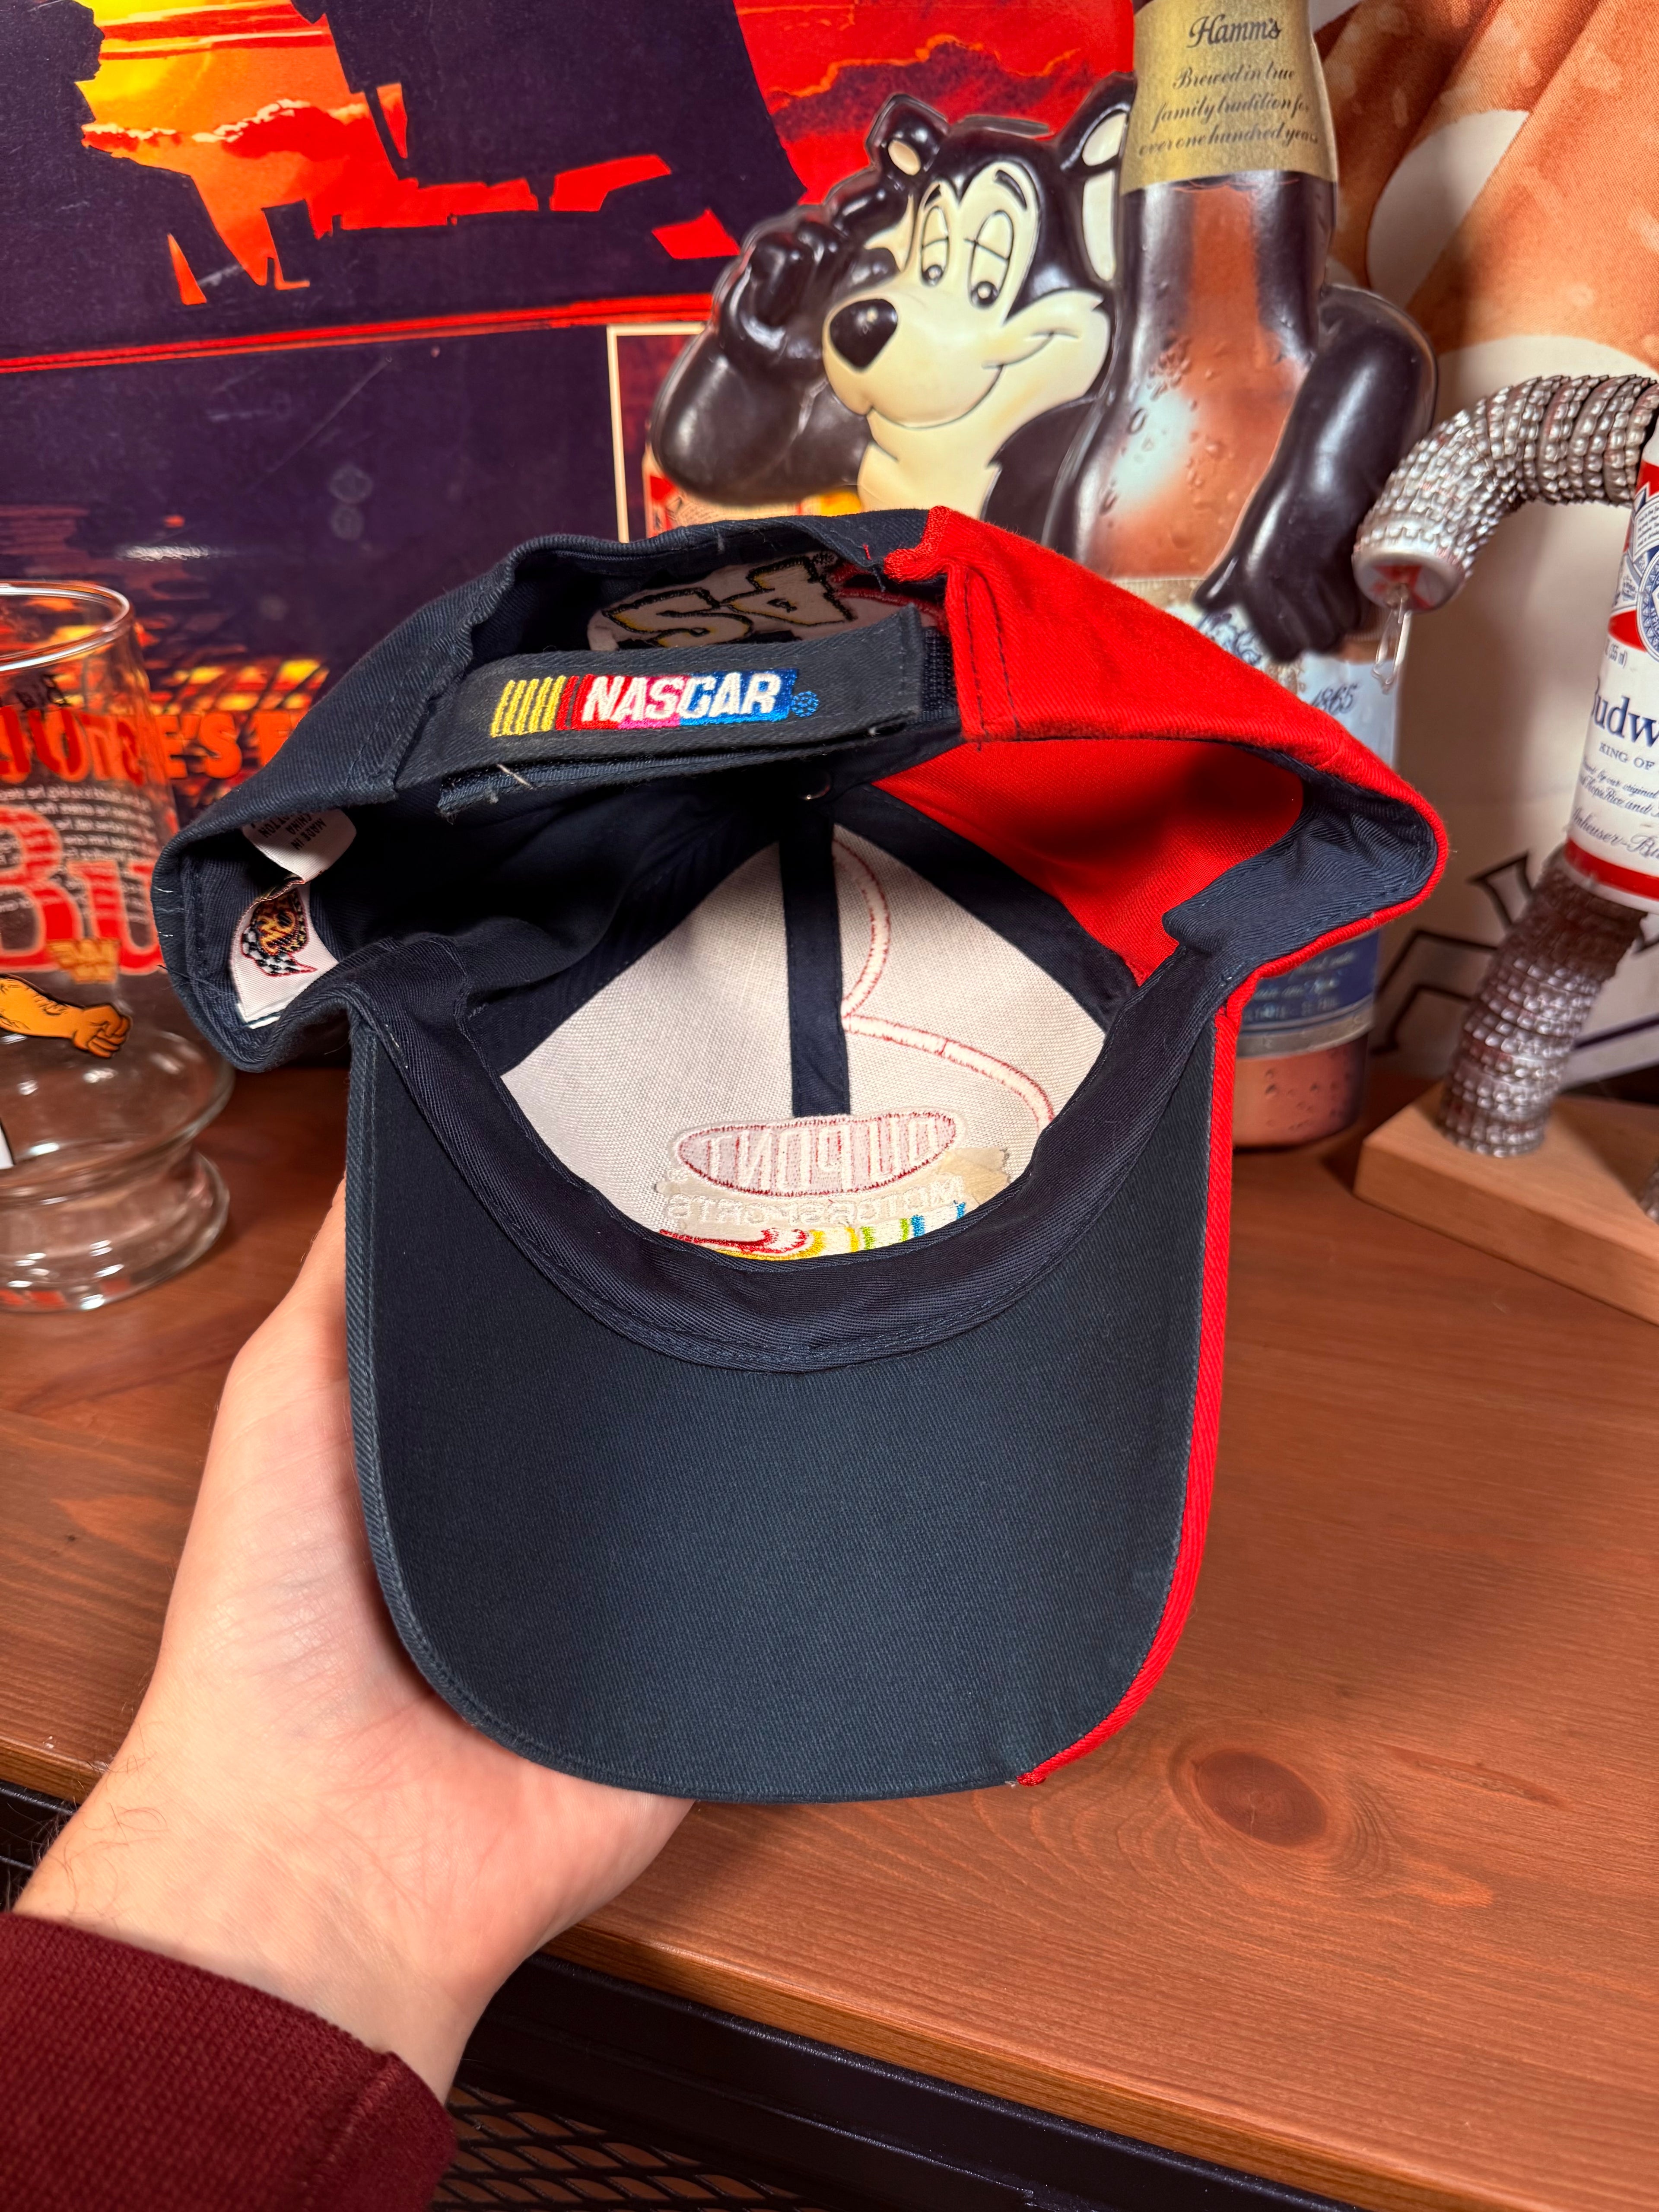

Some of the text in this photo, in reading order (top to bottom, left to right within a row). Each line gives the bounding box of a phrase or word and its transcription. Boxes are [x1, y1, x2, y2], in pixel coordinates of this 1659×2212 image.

[1186, 14, 1282, 48] Hamm's
[1173, 61, 1295, 89] Brewed in true
[1150, 95, 1214, 133] family
[1217, 92, 1291, 114] tradition
[1139, 139, 1172, 156] over
[1175, 135, 1206, 149] one
[1208, 122, 1285, 144] hundred
[581, 672, 780, 722] NASCAR
[1599, 743, 1655, 770] KING OF
[286, 813, 312, 835] CHINA
[291, 818, 327, 850] MADE IN
